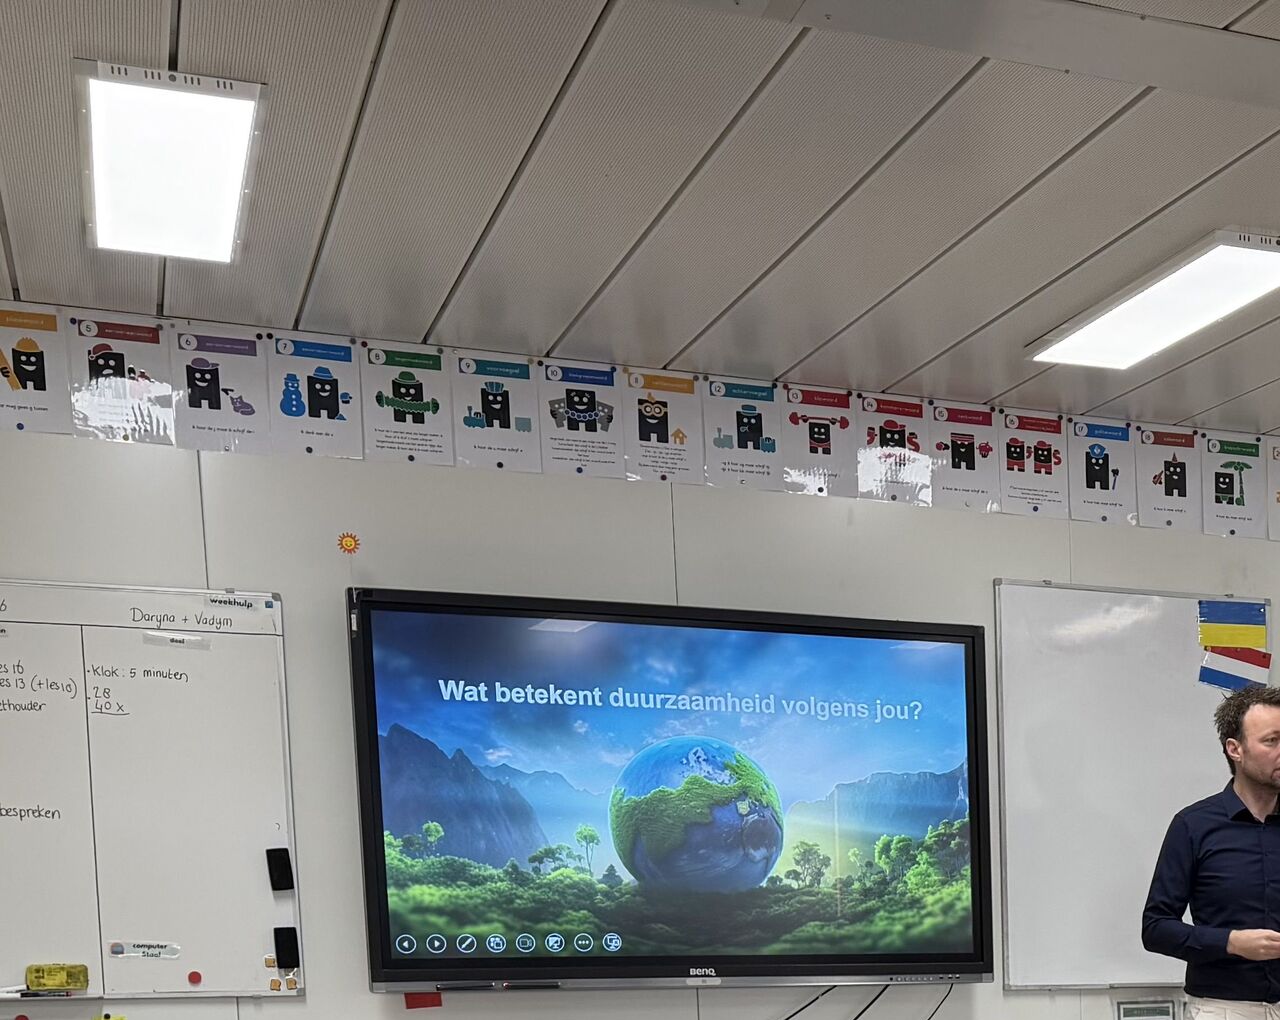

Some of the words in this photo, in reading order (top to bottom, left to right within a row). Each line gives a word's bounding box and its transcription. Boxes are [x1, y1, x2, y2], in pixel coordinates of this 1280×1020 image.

[86, 324, 91, 332] 5
[792, 392, 798, 400] 13
[209, 598, 253, 609] weekhulp
[130, 607, 176, 629] Daryna
[195, 607, 233, 628] Vadym
[13, 660, 24, 674] 16
[130, 668, 136, 678] 5
[142, 667, 188, 682] minuten
[15, 678, 26, 690] 13
[93, 686, 111, 698] 28
[0, 700, 46, 712] ethouder
[94, 701, 112, 714] 40
[438, 680, 488, 702] Wat
[495, 682, 602, 706] betekent
[609, 687, 775, 714] duurzaamheid
[782, 696, 870, 721] volgens
[874, 699, 922, 723] jou?
[690, 968, 716, 976] BenQ
